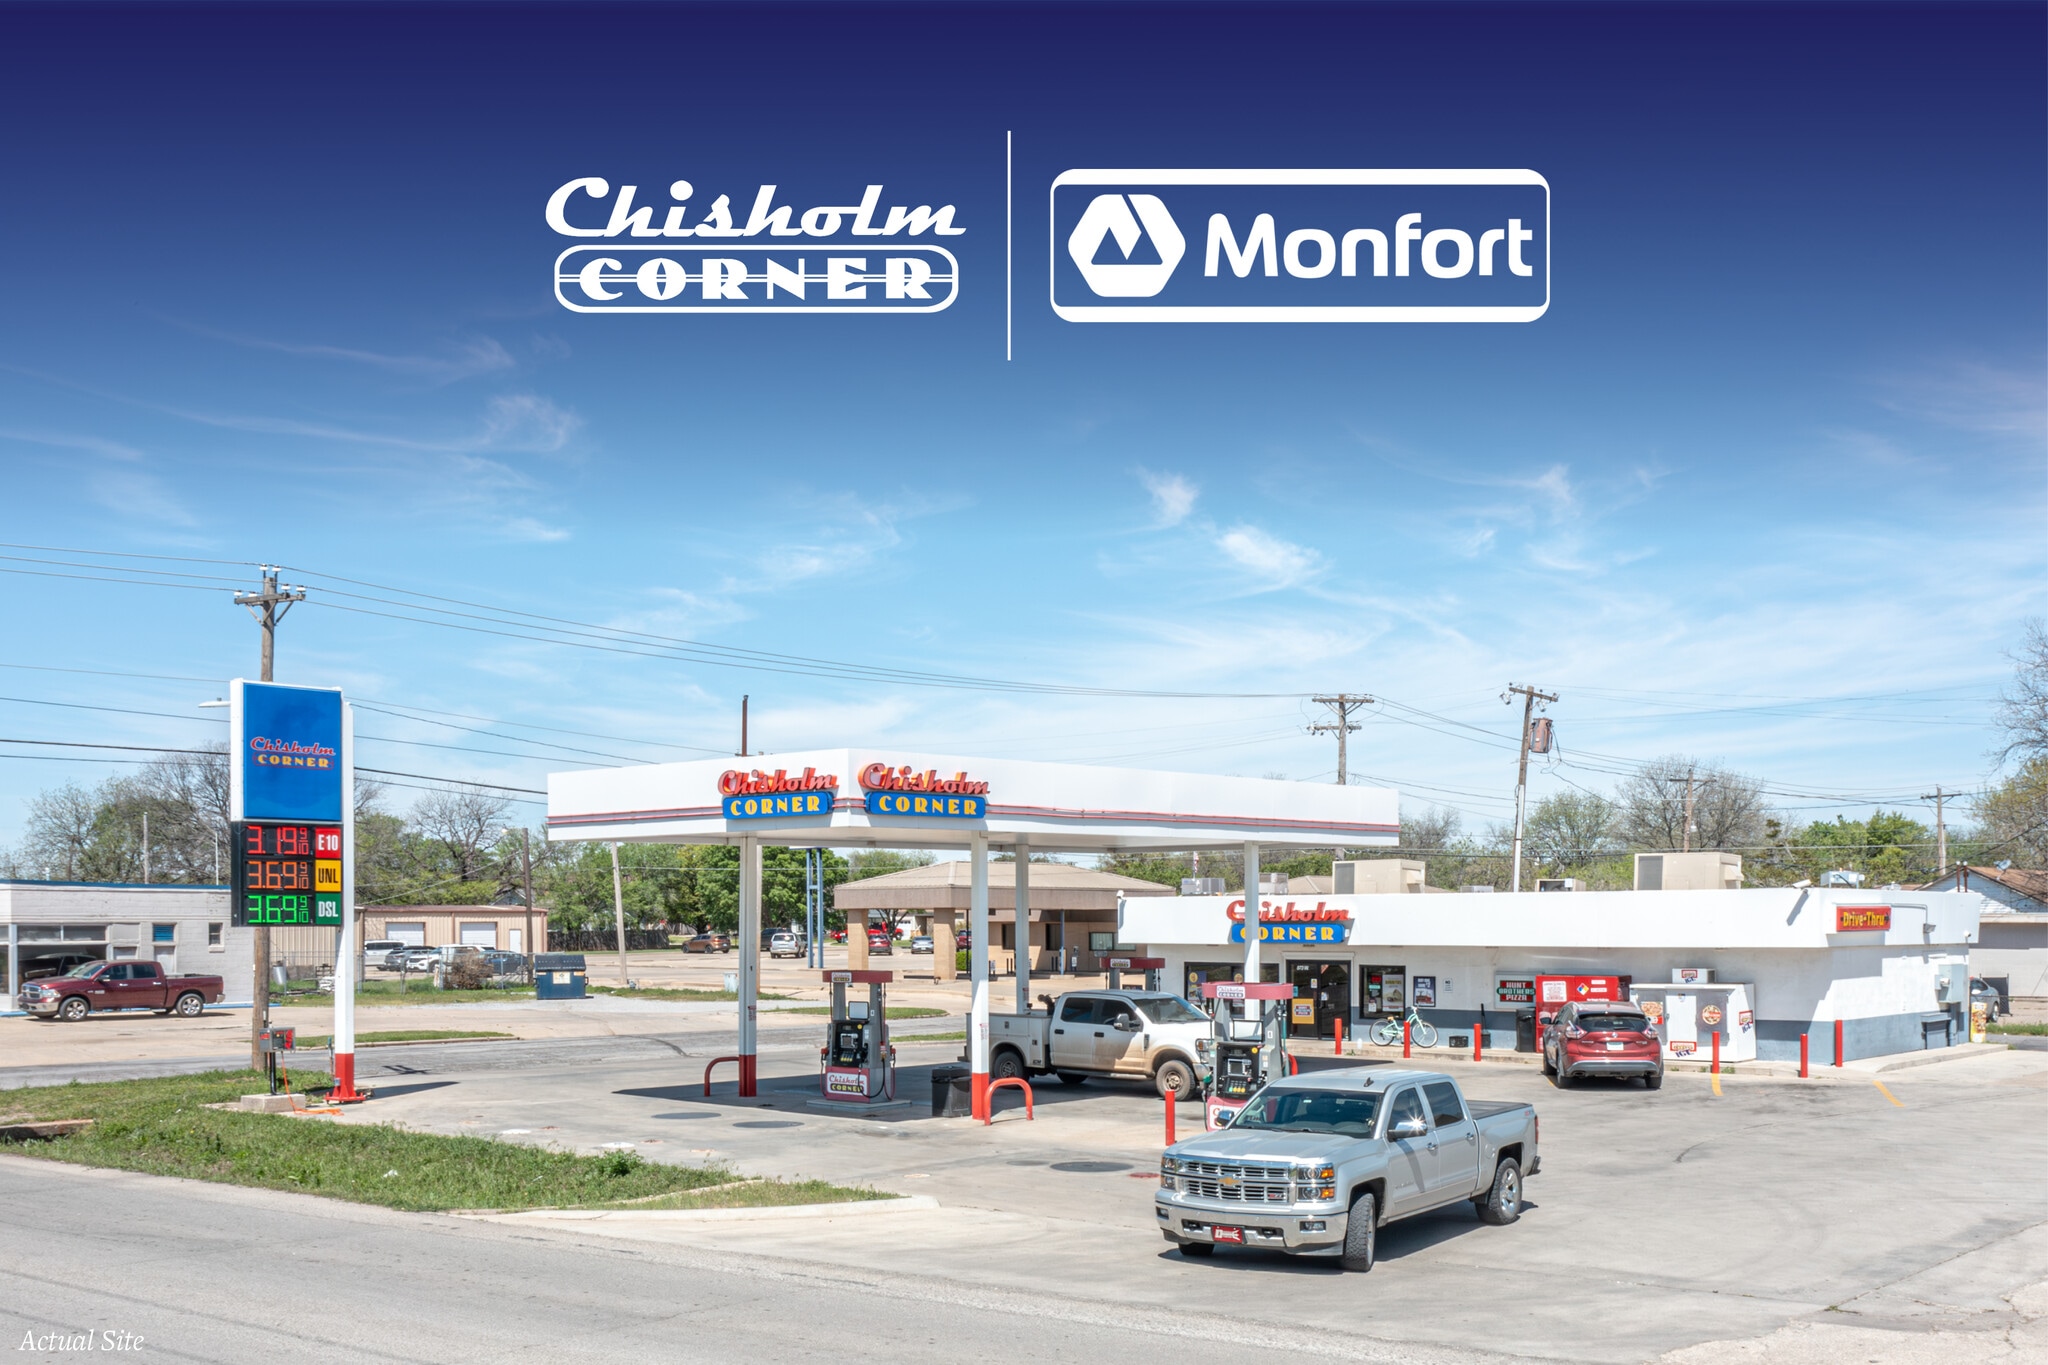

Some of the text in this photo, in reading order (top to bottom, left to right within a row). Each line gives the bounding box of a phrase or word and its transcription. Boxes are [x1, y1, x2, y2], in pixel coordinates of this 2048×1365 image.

[250, 736, 336, 756] Chisholm
[257, 754, 329, 768] CORNER
[718, 767, 838, 796] Chisholm
[858, 763, 990, 794] Chisholm
[730, 796, 820, 816] CORNER
[879, 795, 977, 816] CORNER
[247, 825, 298, 854] 3.19
[248, 861, 298, 889] 3.69
[318, 868, 339, 883] UNL
[247, 895, 298, 923] 3.69
[318, 901, 339, 918] DSL
[1226, 900, 1350, 921] Cisholm
[1499, 987, 1535, 995] BROTHERS
